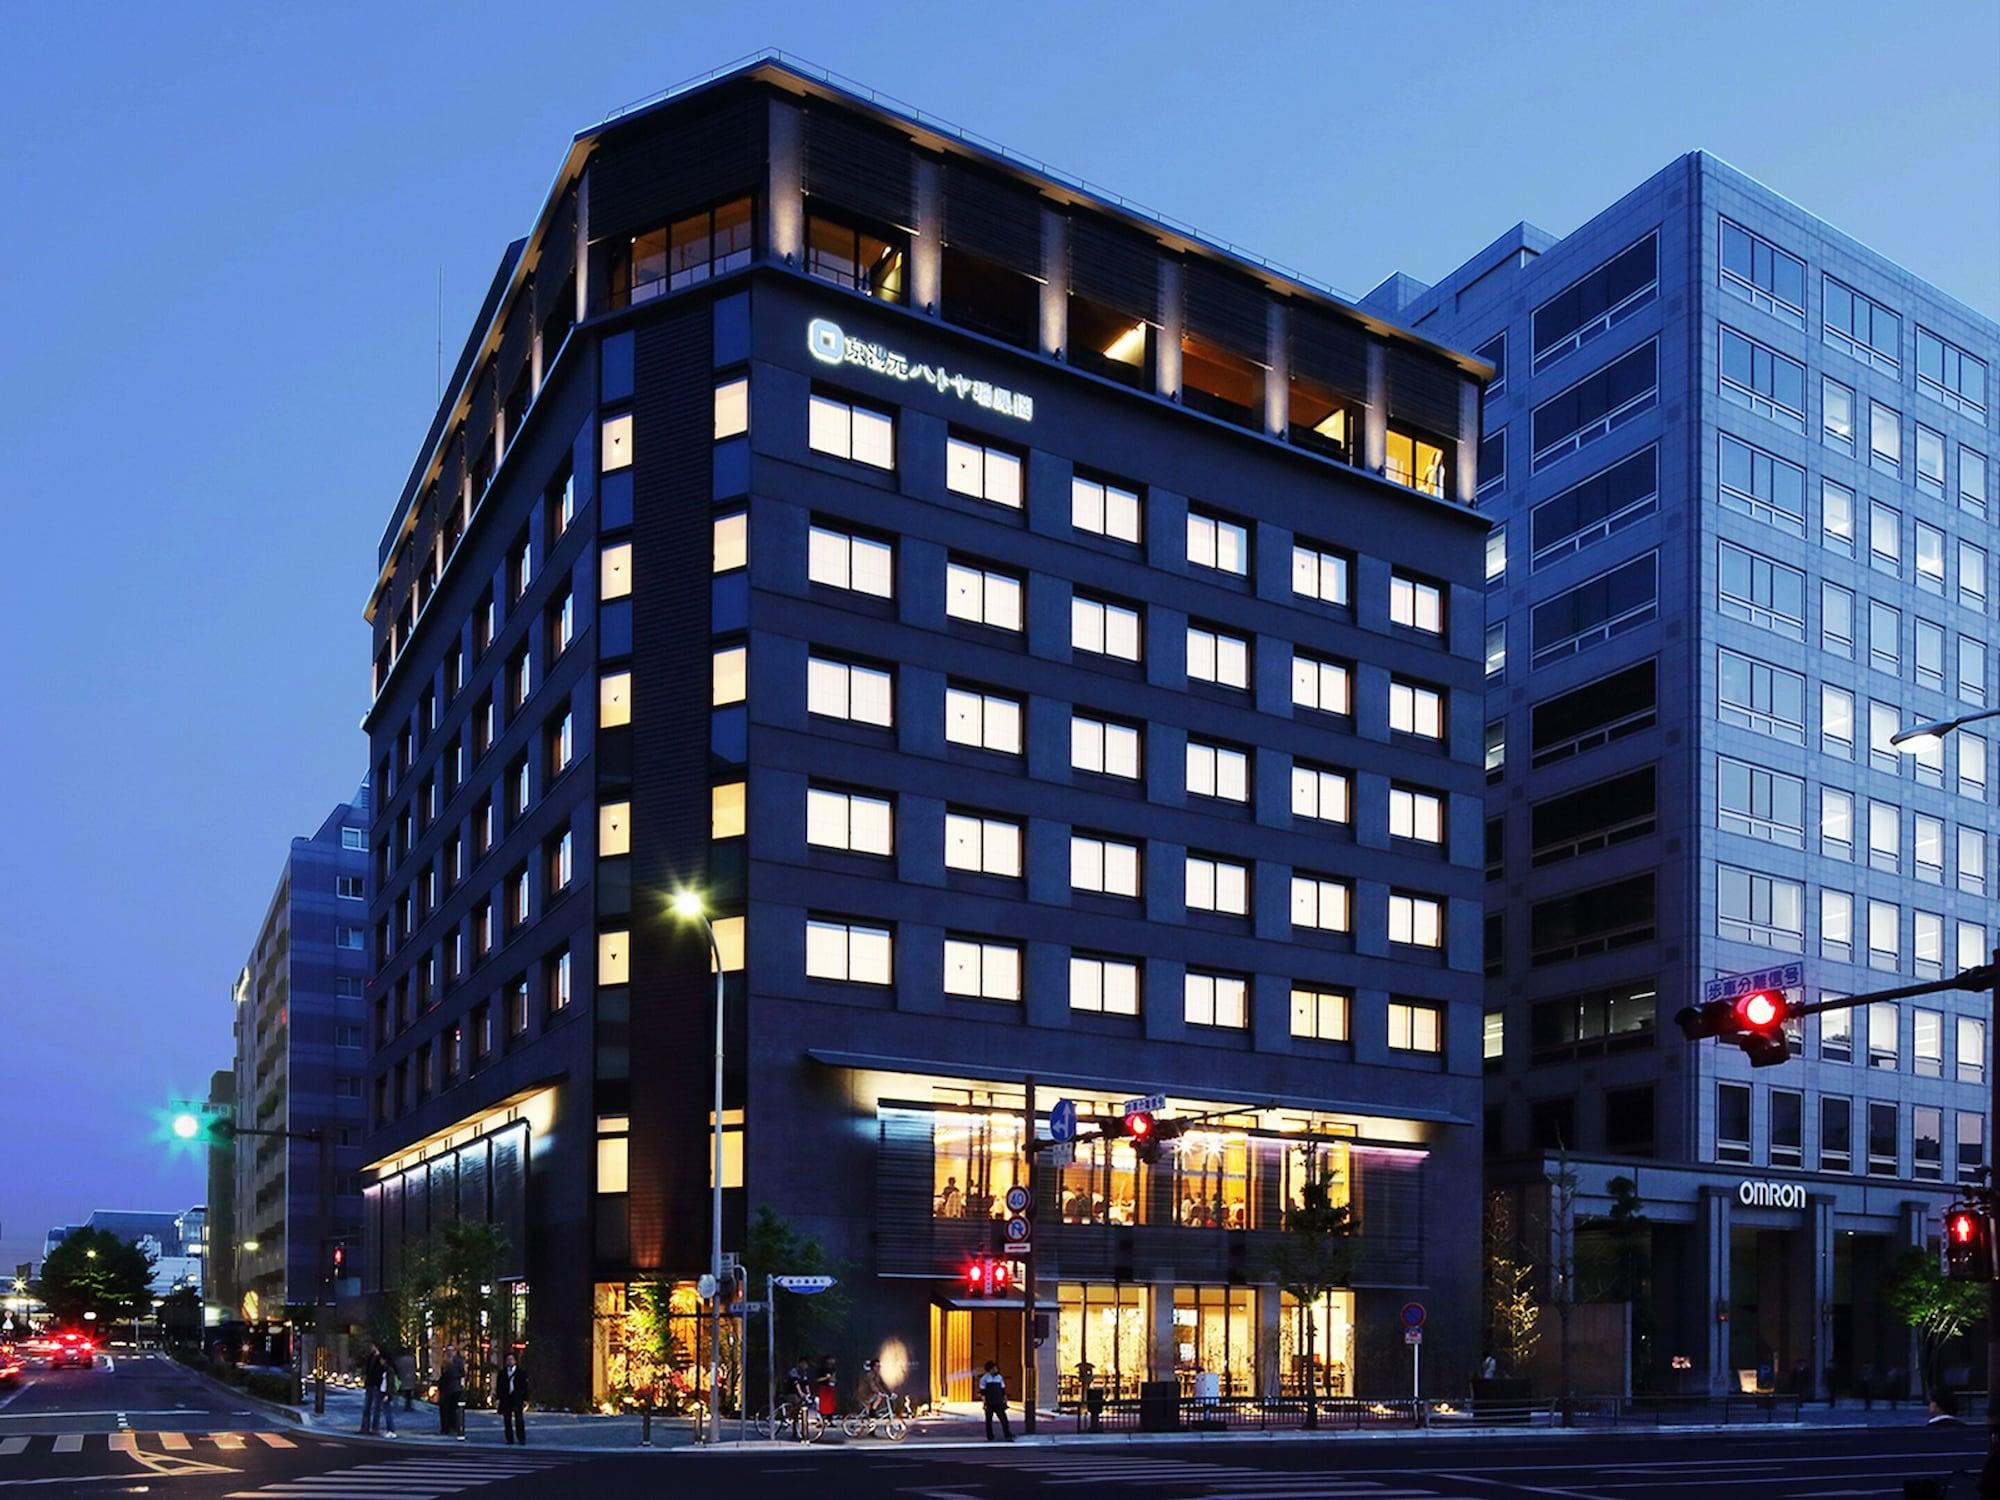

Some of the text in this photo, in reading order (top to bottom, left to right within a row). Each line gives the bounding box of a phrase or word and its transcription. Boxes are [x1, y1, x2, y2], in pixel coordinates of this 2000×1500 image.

[1708, 966, 1799, 1001] 歩車分離信号
[1010, 1192, 1024, 1206] 40
[1739, 1180, 1807, 1209] OMRON
